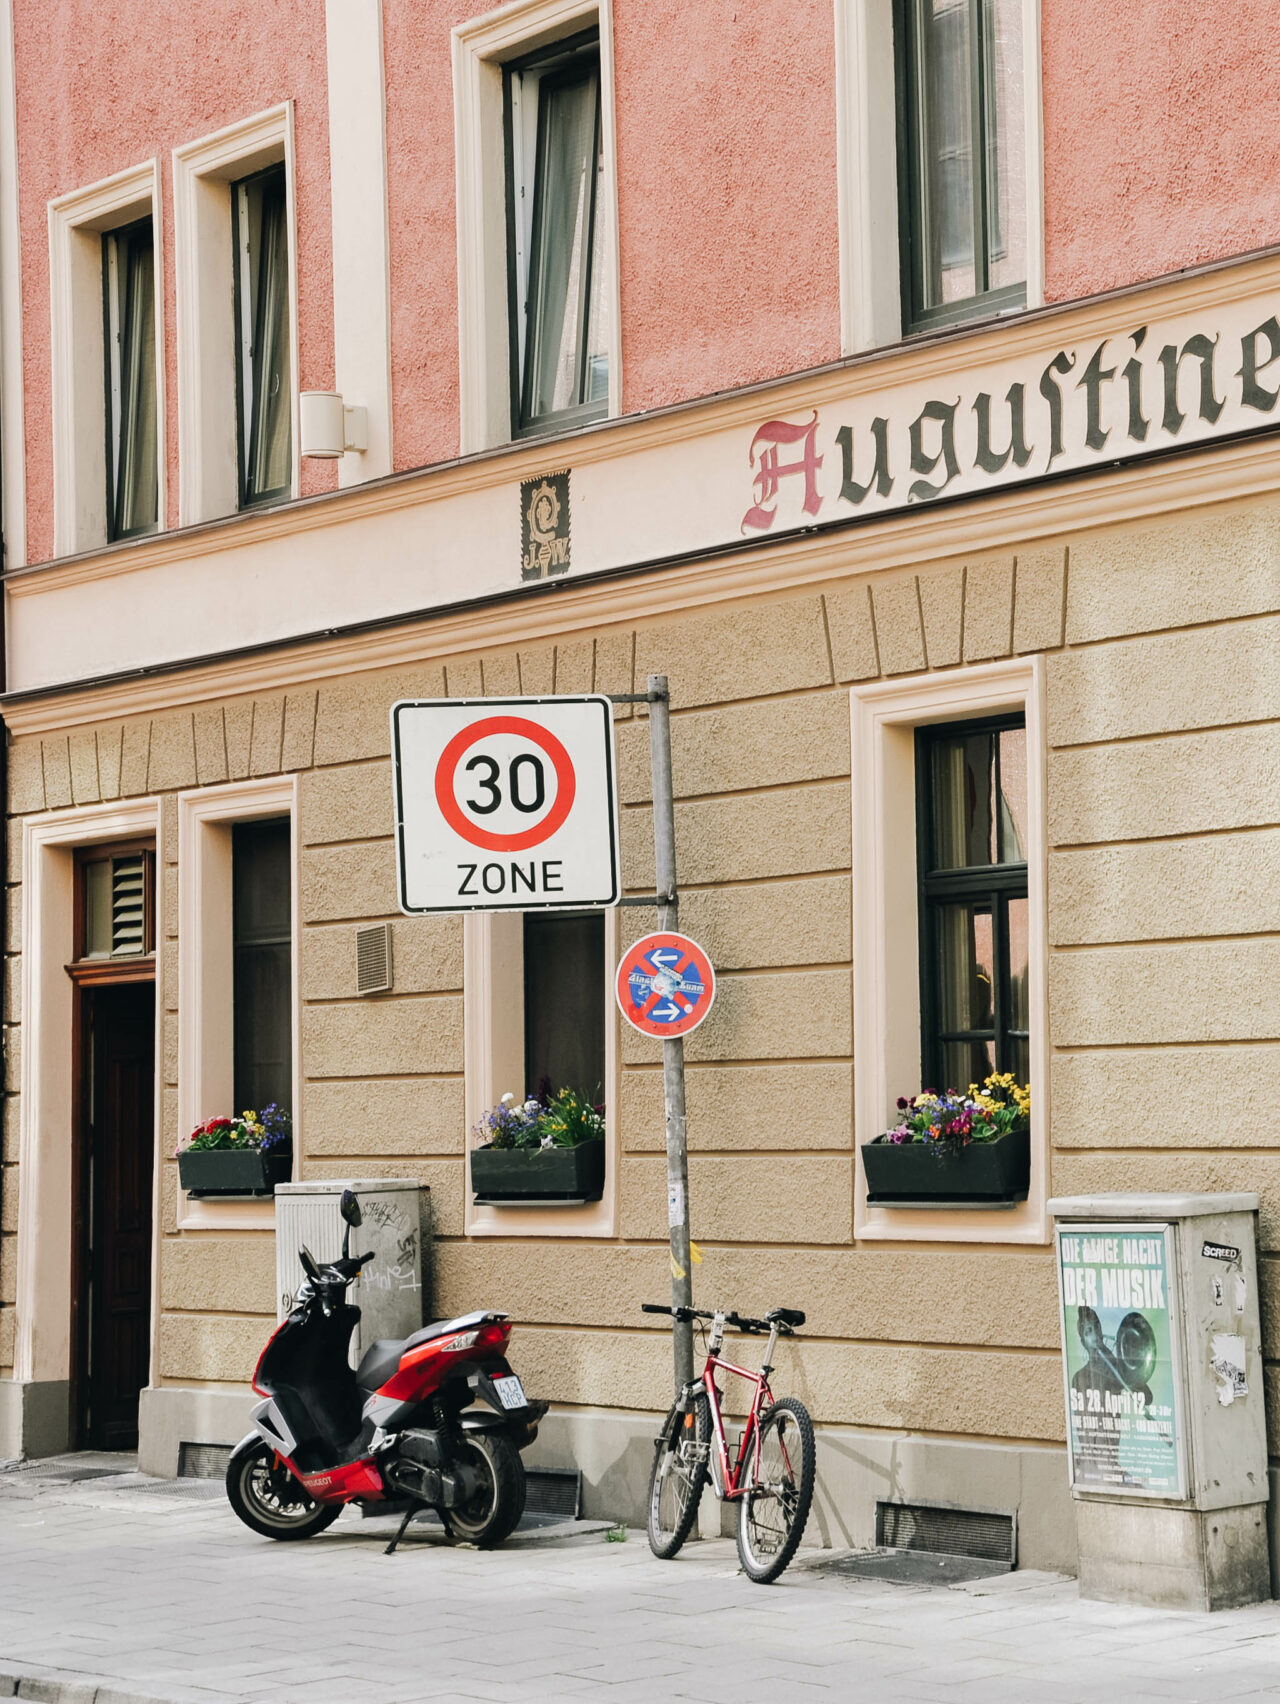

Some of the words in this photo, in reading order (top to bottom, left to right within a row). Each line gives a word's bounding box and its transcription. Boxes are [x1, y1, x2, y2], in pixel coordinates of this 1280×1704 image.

[465, 753, 545, 814] 30
[457, 860, 564, 895] ZONE
[1061, 1238, 1080, 1263] DIE
[1122, 1239, 1161, 1264] NACHT
[1063, 1267, 1097, 1307] DER
[1101, 1268, 1166, 1308] MUSIK
[1070, 1388, 1084, 1411] Sa
[1086, 1389, 1104, 1412] 28.
[1105, 1389, 1130, 1417] April
[303, 1476, 332, 1487] PEUGEOT
